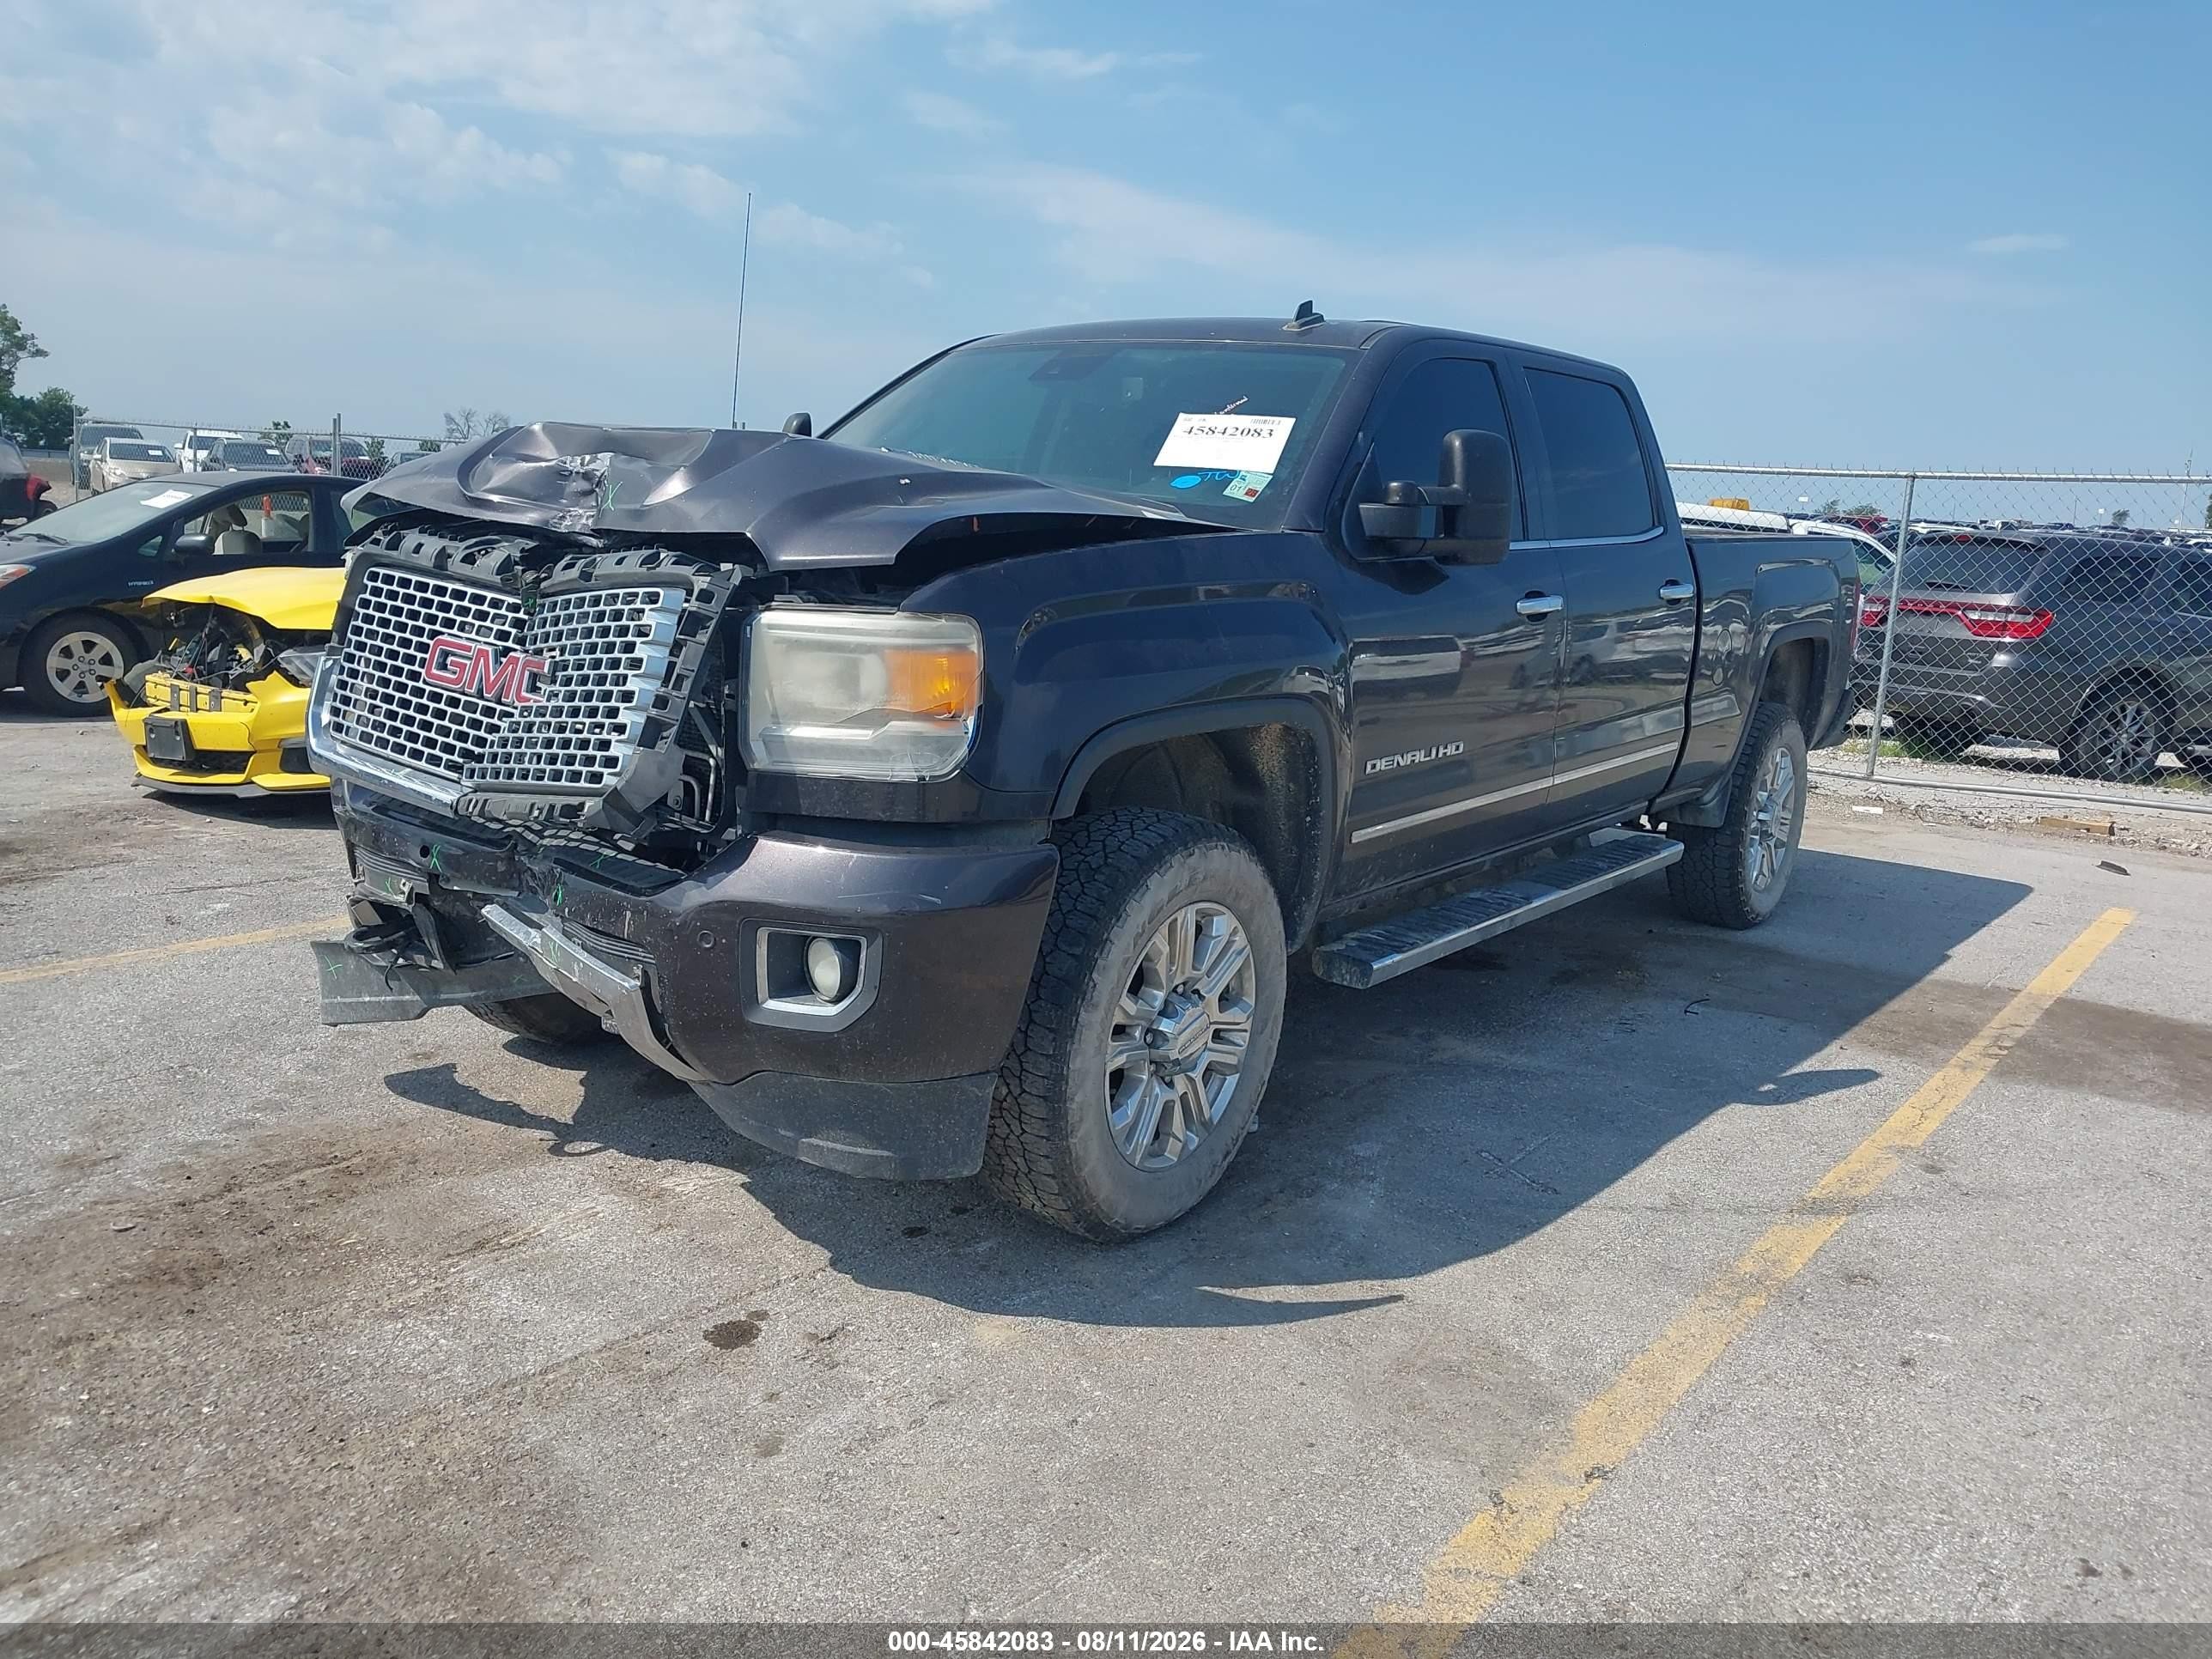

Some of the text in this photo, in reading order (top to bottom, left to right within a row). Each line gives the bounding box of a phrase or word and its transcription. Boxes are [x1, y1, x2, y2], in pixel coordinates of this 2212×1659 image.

[1182, 425, 1274, 439] 45842083
[424, 635, 550, 705] GMC
[1364, 740, 1464, 775] DENALI HD
